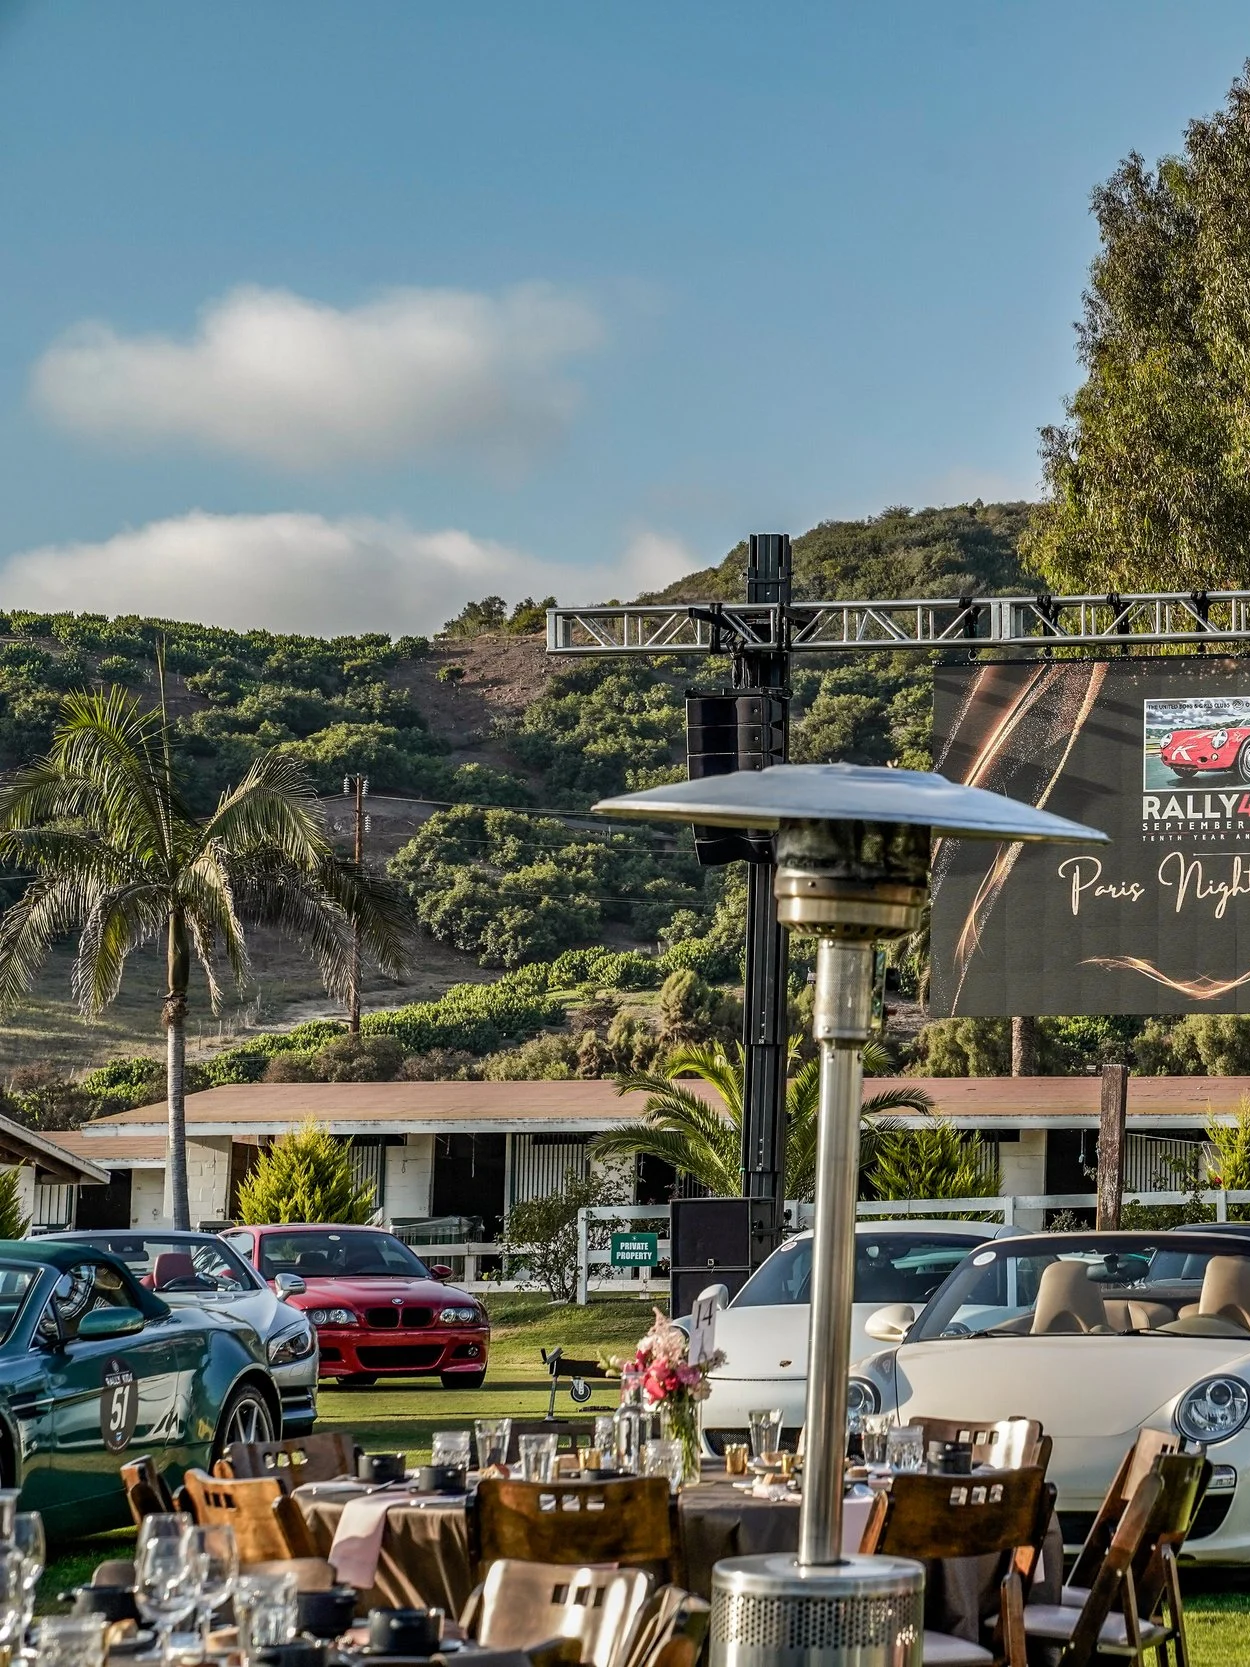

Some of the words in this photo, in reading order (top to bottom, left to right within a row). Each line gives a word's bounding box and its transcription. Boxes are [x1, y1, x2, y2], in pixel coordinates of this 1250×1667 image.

[1142, 820, 1245, 831] SEPTEMBER
[1142, 834, 1182, 842] TENTH
[1193, 833, 1225, 841] YEAR
[1058, 856, 1145, 915] Paris
[620, 1242, 649, 1250] PRIVATE
[616, 1251, 653, 1260] PROPERTY
[695, 1300, 713, 1329] 14
[109, 1384, 130, 1432] 51
